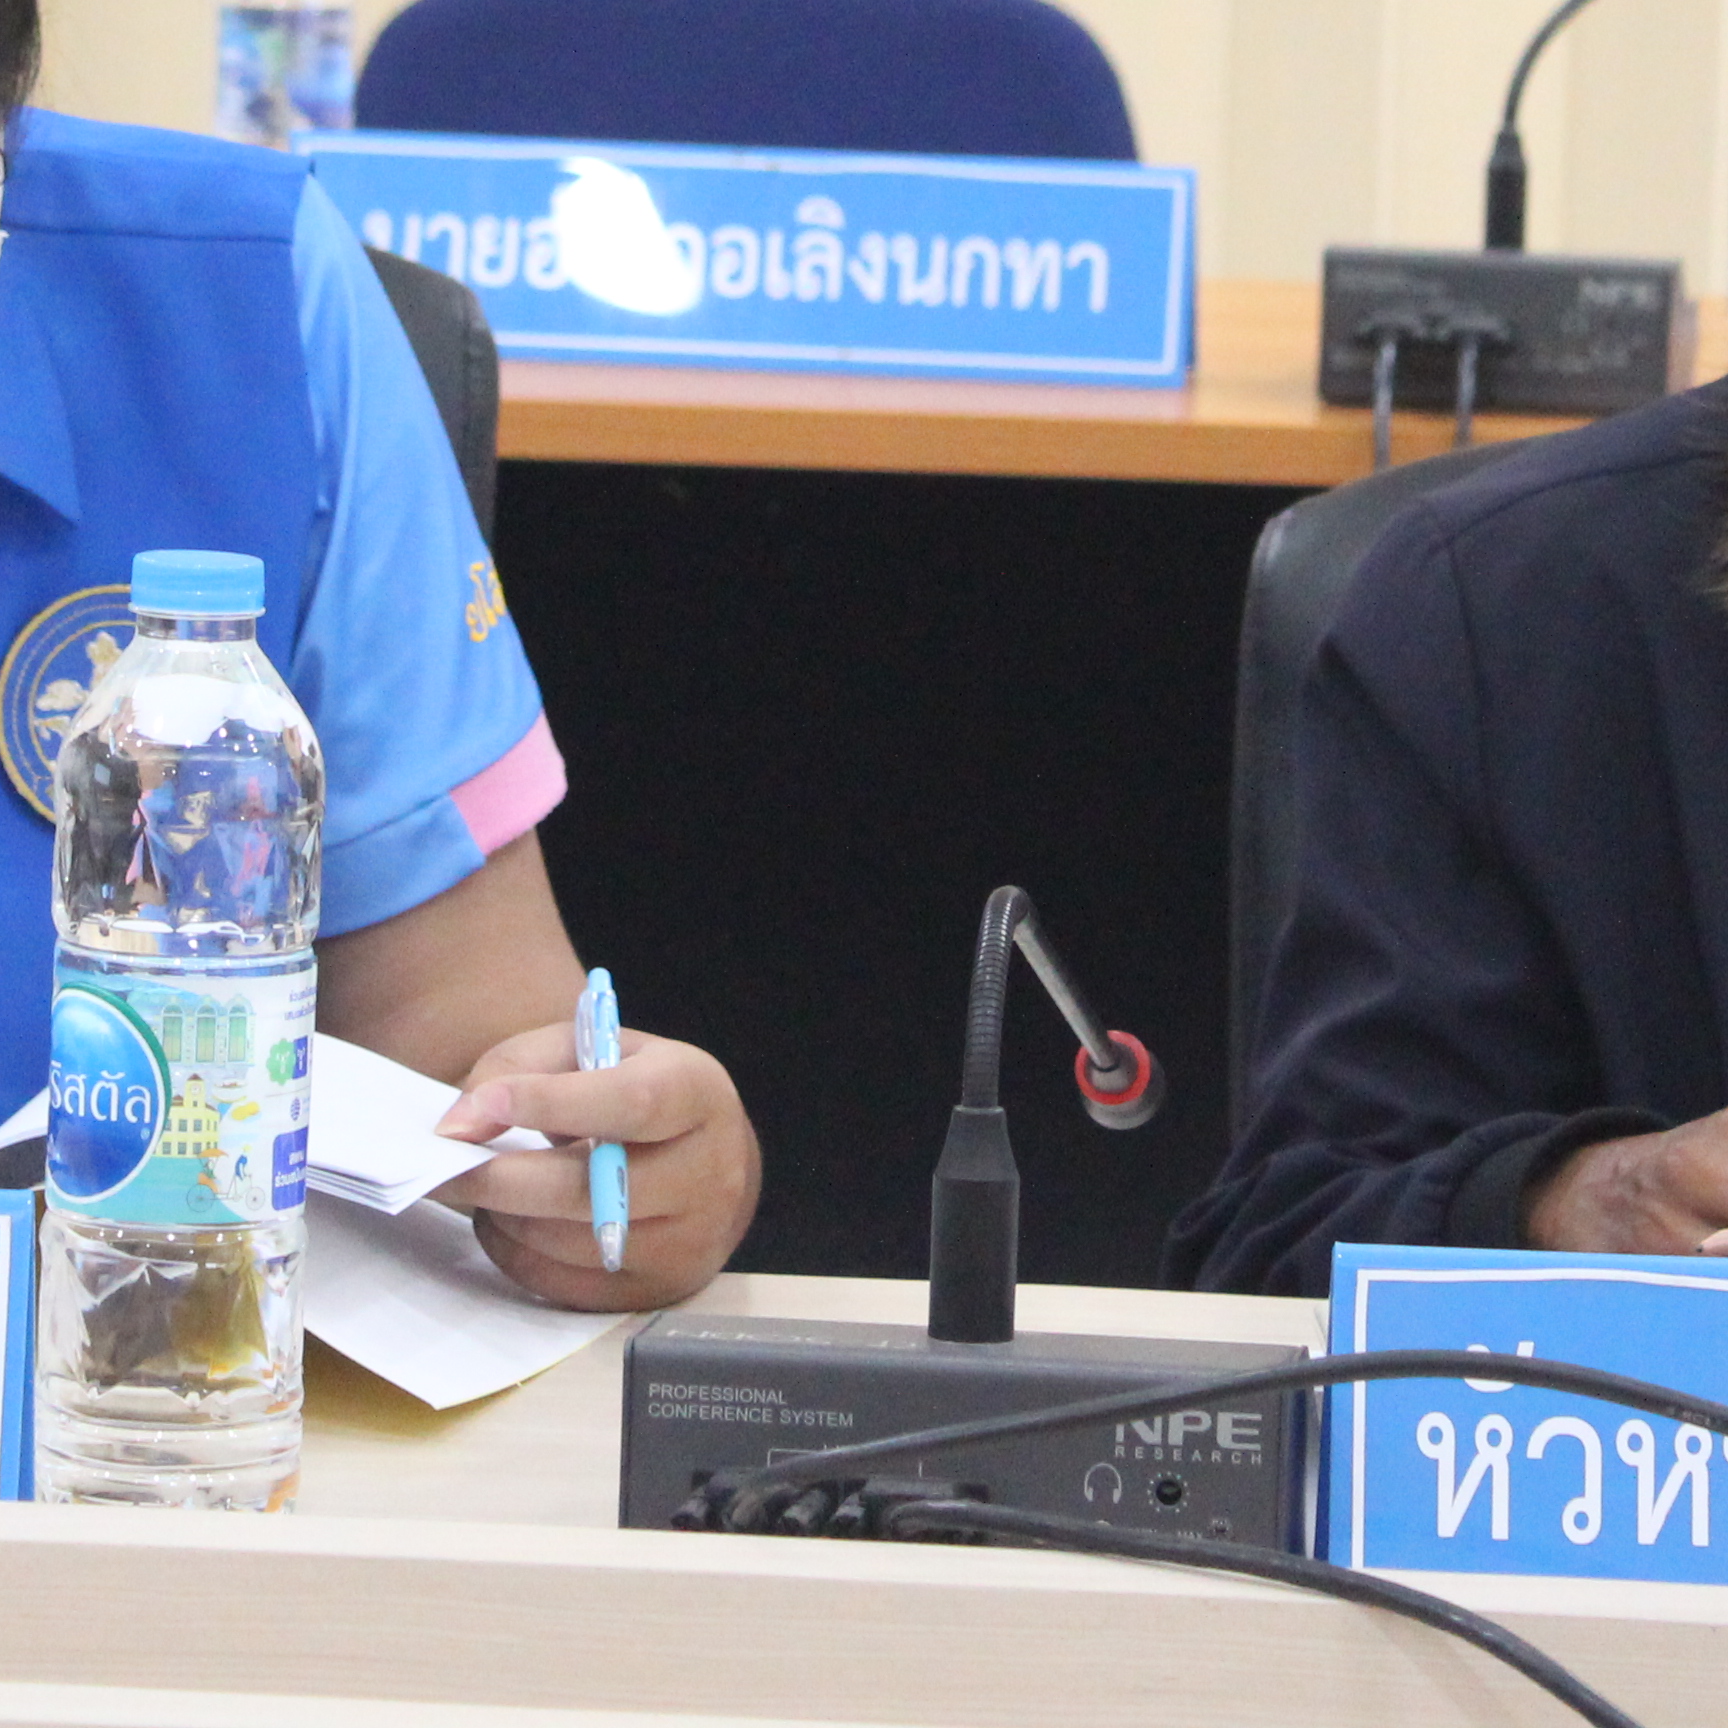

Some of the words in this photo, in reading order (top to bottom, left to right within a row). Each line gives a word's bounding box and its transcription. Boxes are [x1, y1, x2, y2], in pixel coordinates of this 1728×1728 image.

[648, 1383, 787, 1405] PROFESSIONAL
[647, 1403, 773, 1424] CONFERENCE
[779, 1409, 854, 1428] SYSTEM
[1115, 1410, 1263, 1451] NPE
[1114, 1446, 1263, 1465] RESEARCH
